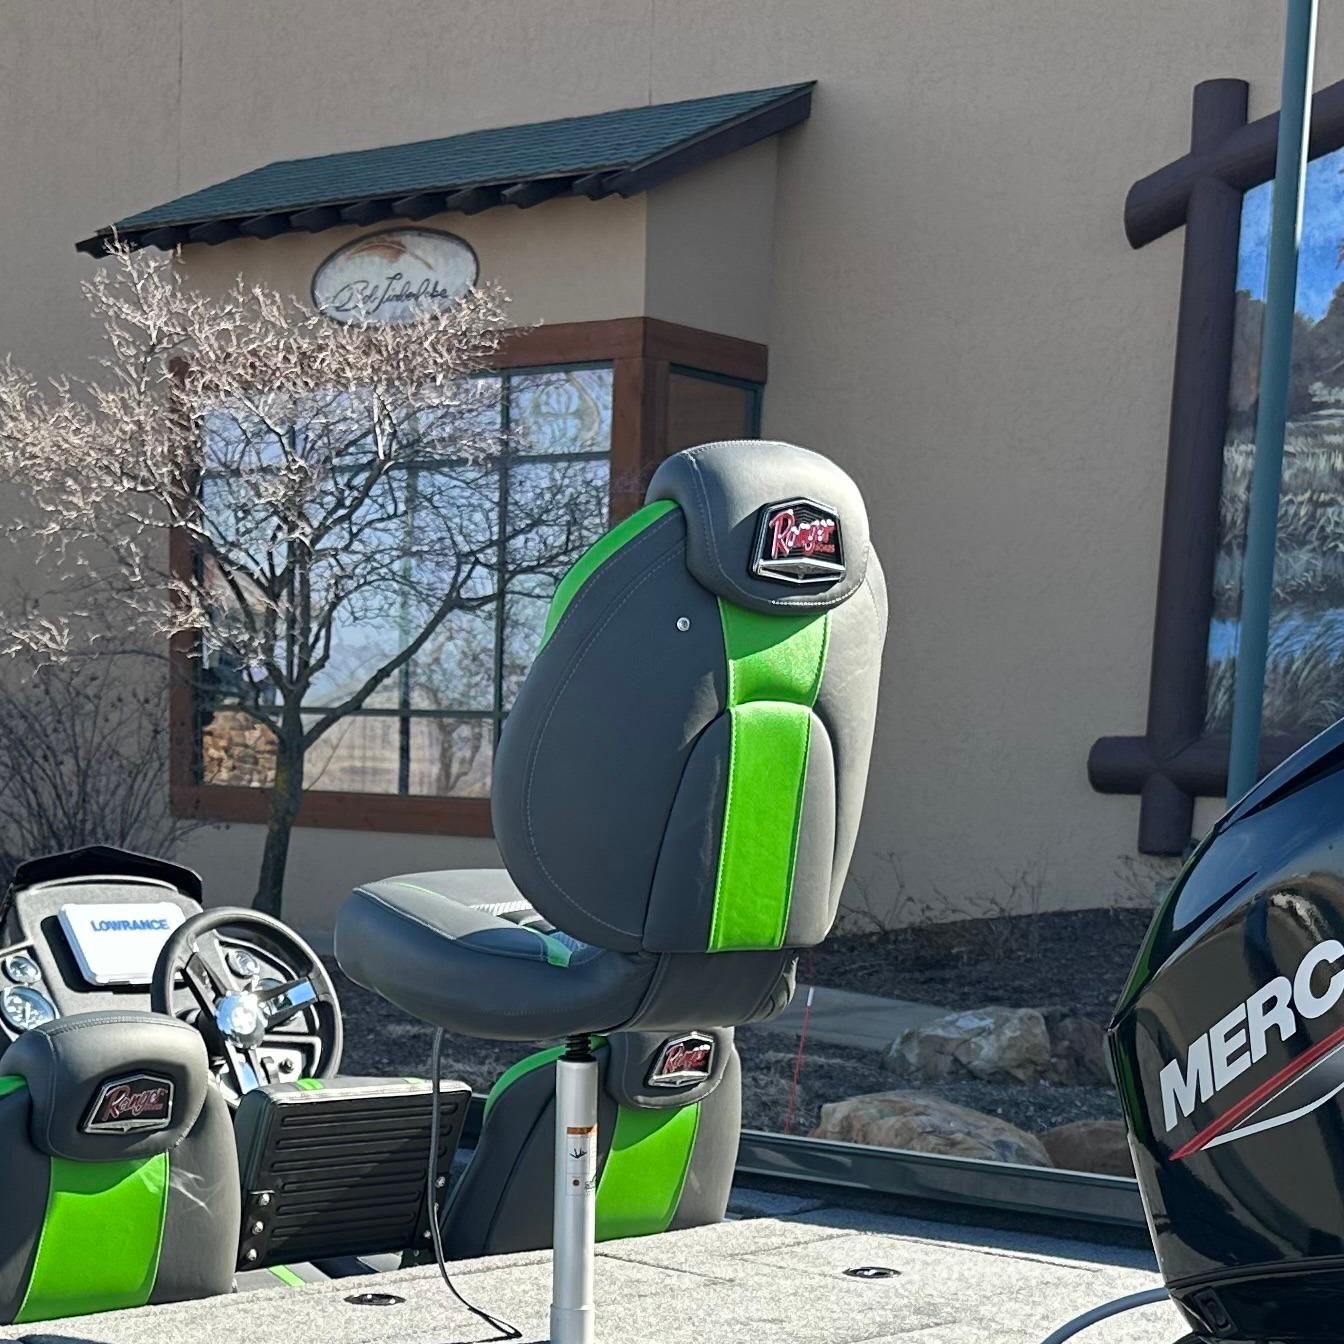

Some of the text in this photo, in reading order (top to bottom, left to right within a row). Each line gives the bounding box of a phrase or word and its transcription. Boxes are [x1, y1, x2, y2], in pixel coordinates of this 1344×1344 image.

[769, 509, 835, 559] Ranger
[90, 919, 170, 932] LOWRANCE
[101, 1084, 169, 1121] Ranger
